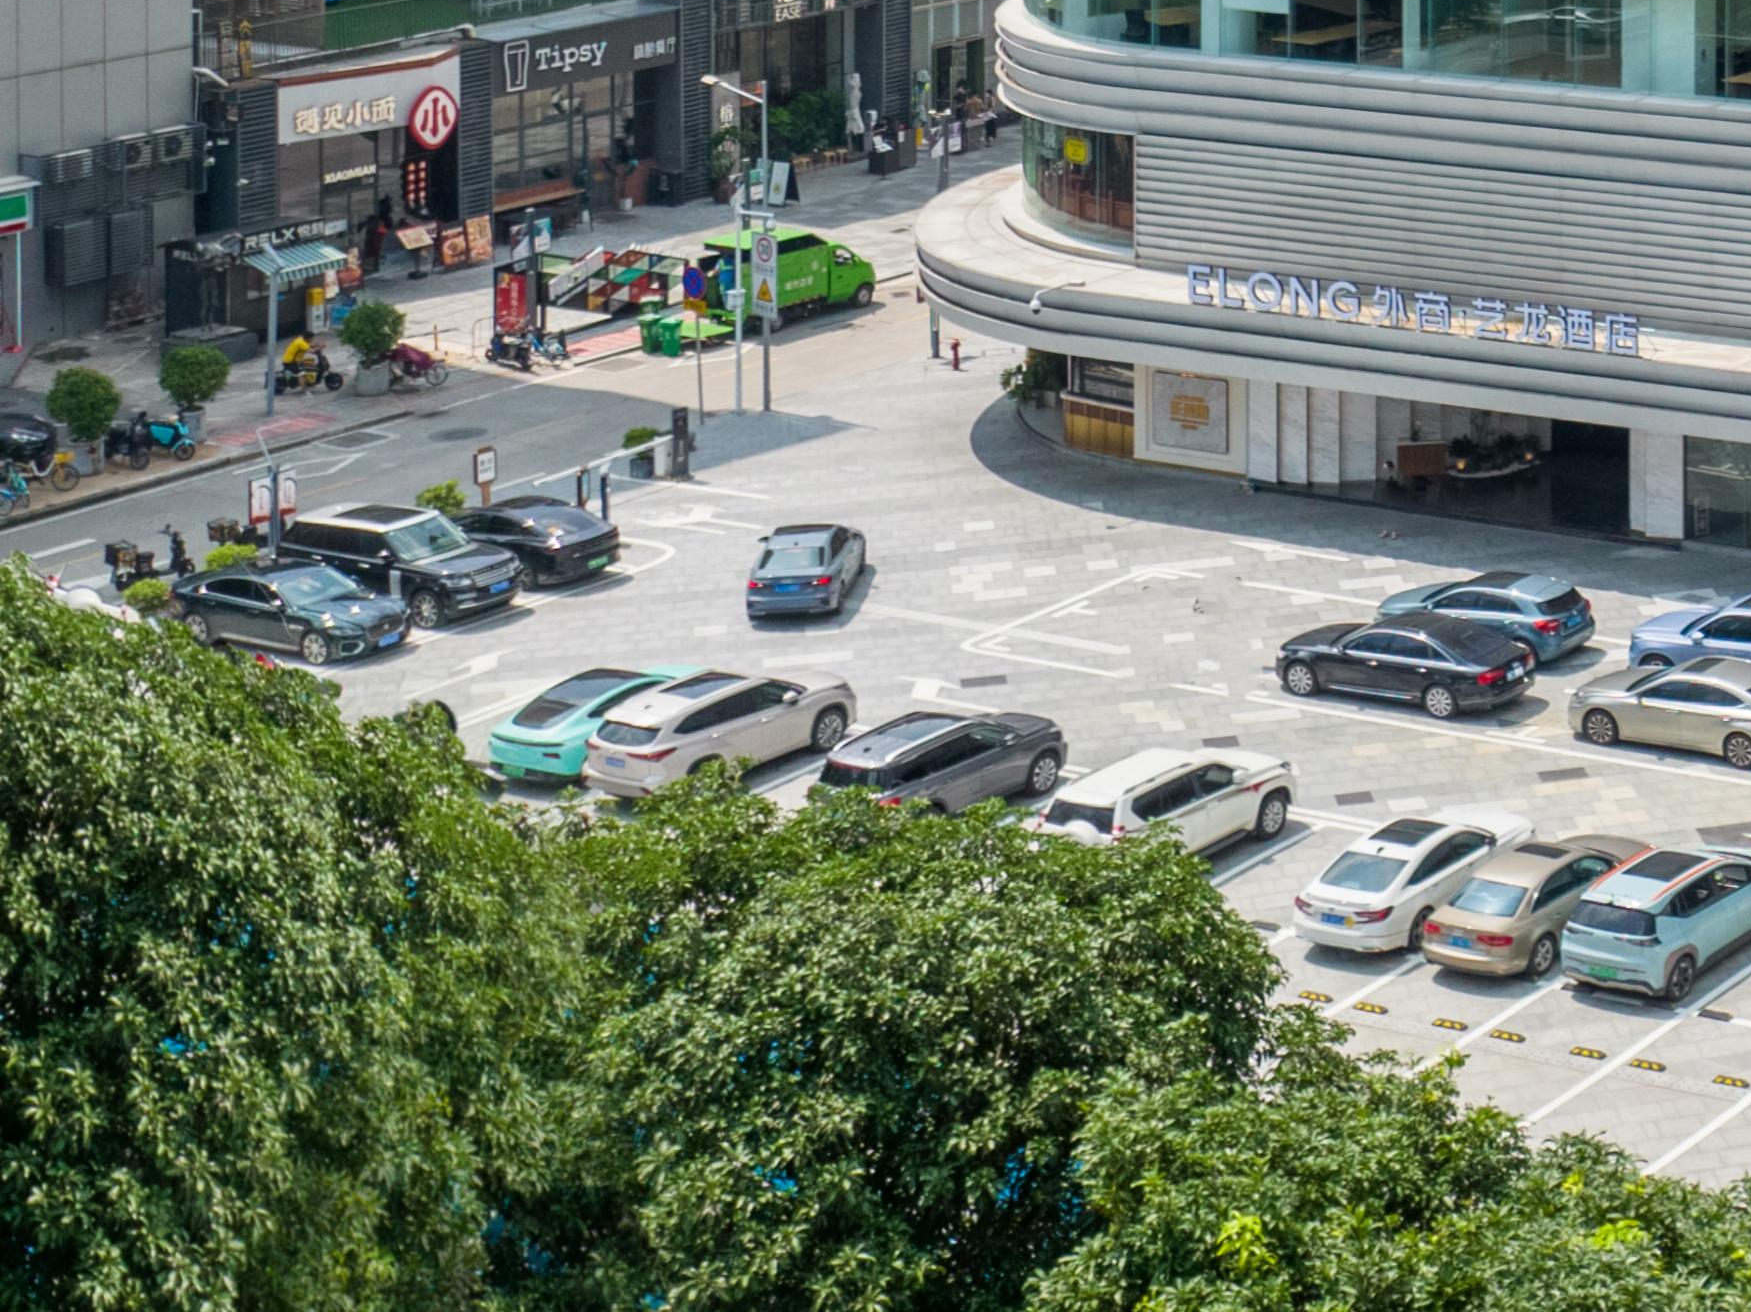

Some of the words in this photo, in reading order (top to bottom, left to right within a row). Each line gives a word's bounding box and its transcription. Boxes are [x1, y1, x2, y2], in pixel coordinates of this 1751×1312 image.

[775, 6, 801, 23] EASE
[535, 40, 607, 73] Tipsy
[294, 95, 396, 134] 遇见小面
[420, 96, 450, 139] 小
[245, 227, 295, 251] RELX
[1187, 264, 1362, 319] ELONG
[1373, 285, 1641, 356] 外商·艺龙酒店
